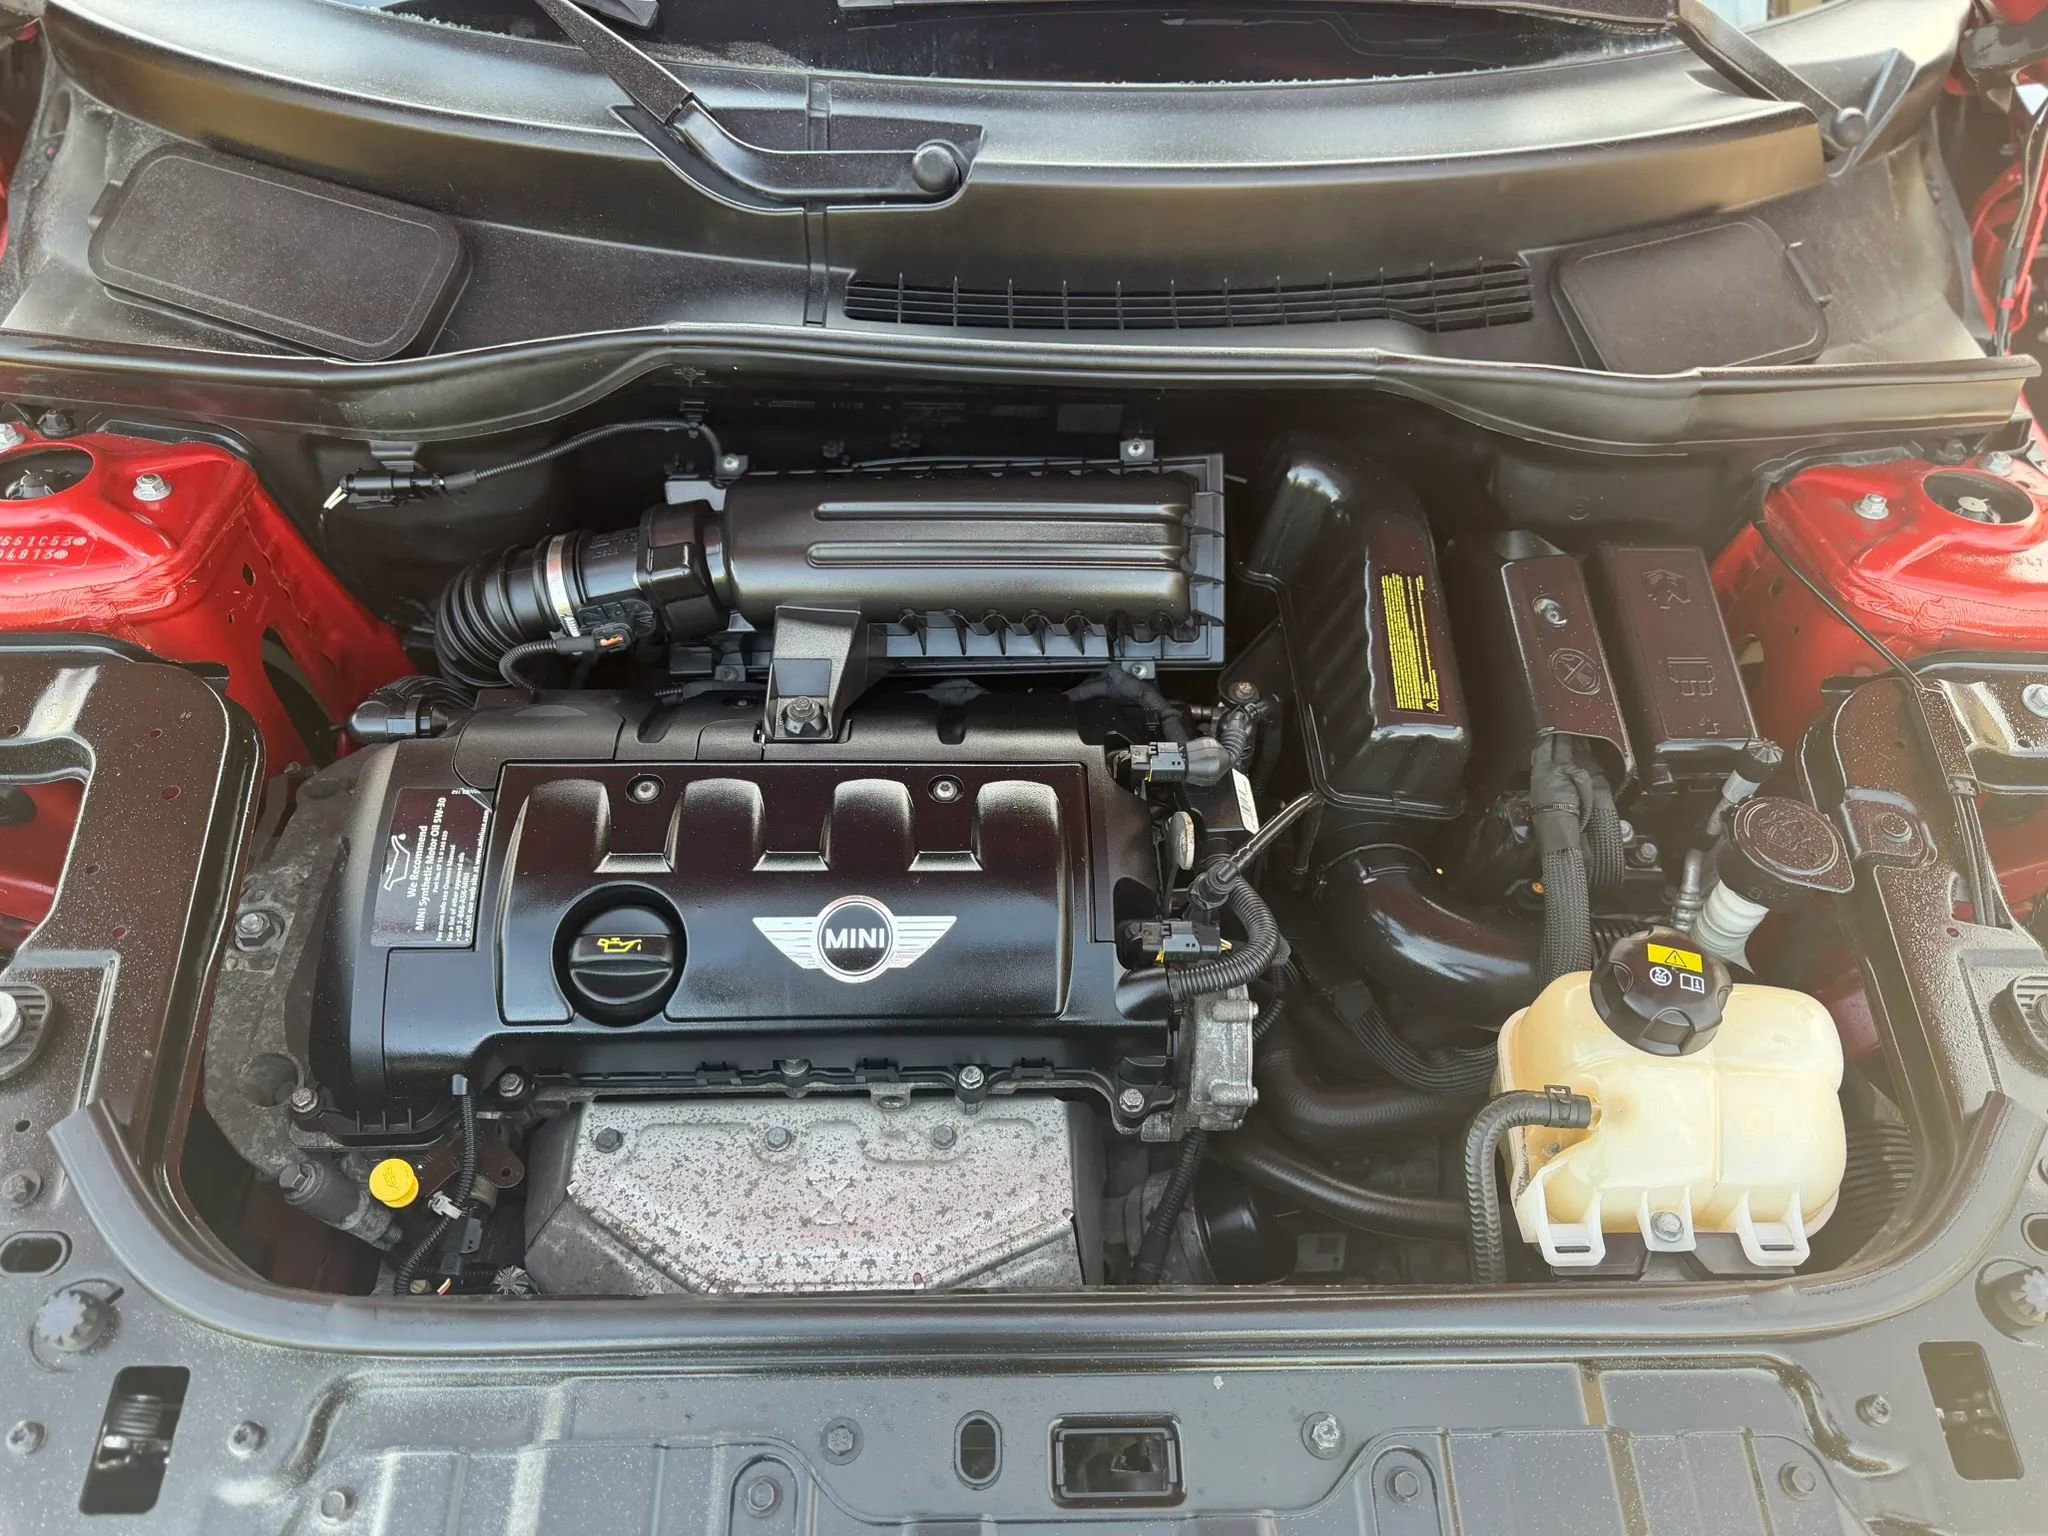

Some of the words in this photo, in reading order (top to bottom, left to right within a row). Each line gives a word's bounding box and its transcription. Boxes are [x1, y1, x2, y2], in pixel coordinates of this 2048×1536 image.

[433, 798, 446, 823] 5W-30
[431, 825, 440, 836] Oil
[410, 826, 428, 879] Recommend
[425, 838, 437, 864] Motor
[407, 882, 417, 897] We
[419, 866, 433, 906] Synthetic
[415, 908, 426, 930] MINI
[825, 927, 885, 949] MINI
